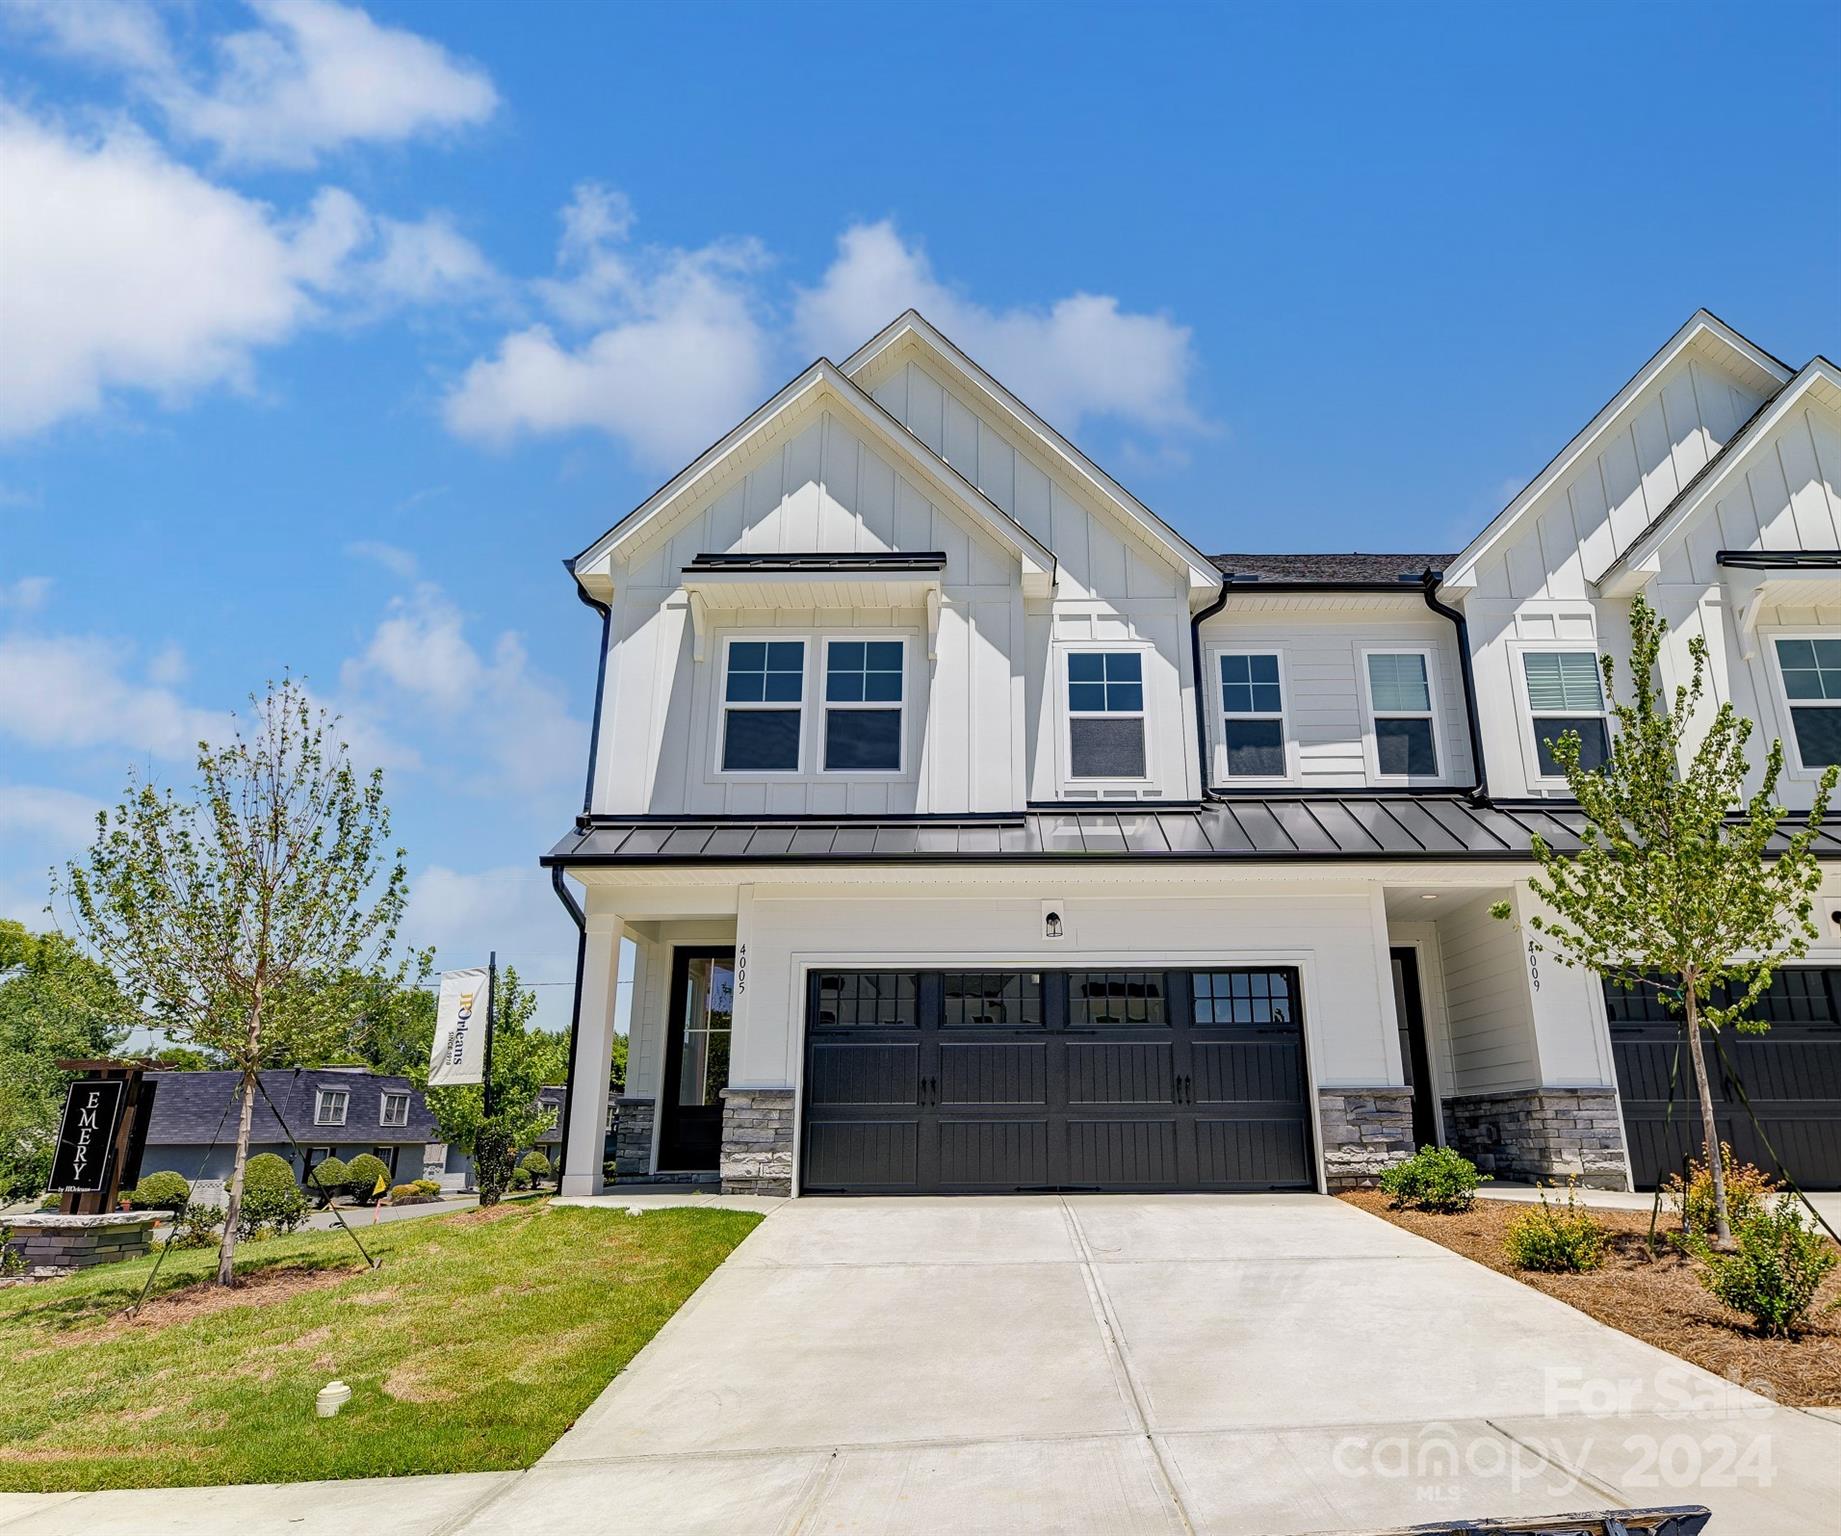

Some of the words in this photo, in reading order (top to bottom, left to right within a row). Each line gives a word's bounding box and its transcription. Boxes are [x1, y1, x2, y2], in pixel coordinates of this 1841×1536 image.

[738, 943, 746, 995] 4005
[1528, 940, 1540, 992] 4009
[73, 1092, 100, 1180] EMERY
